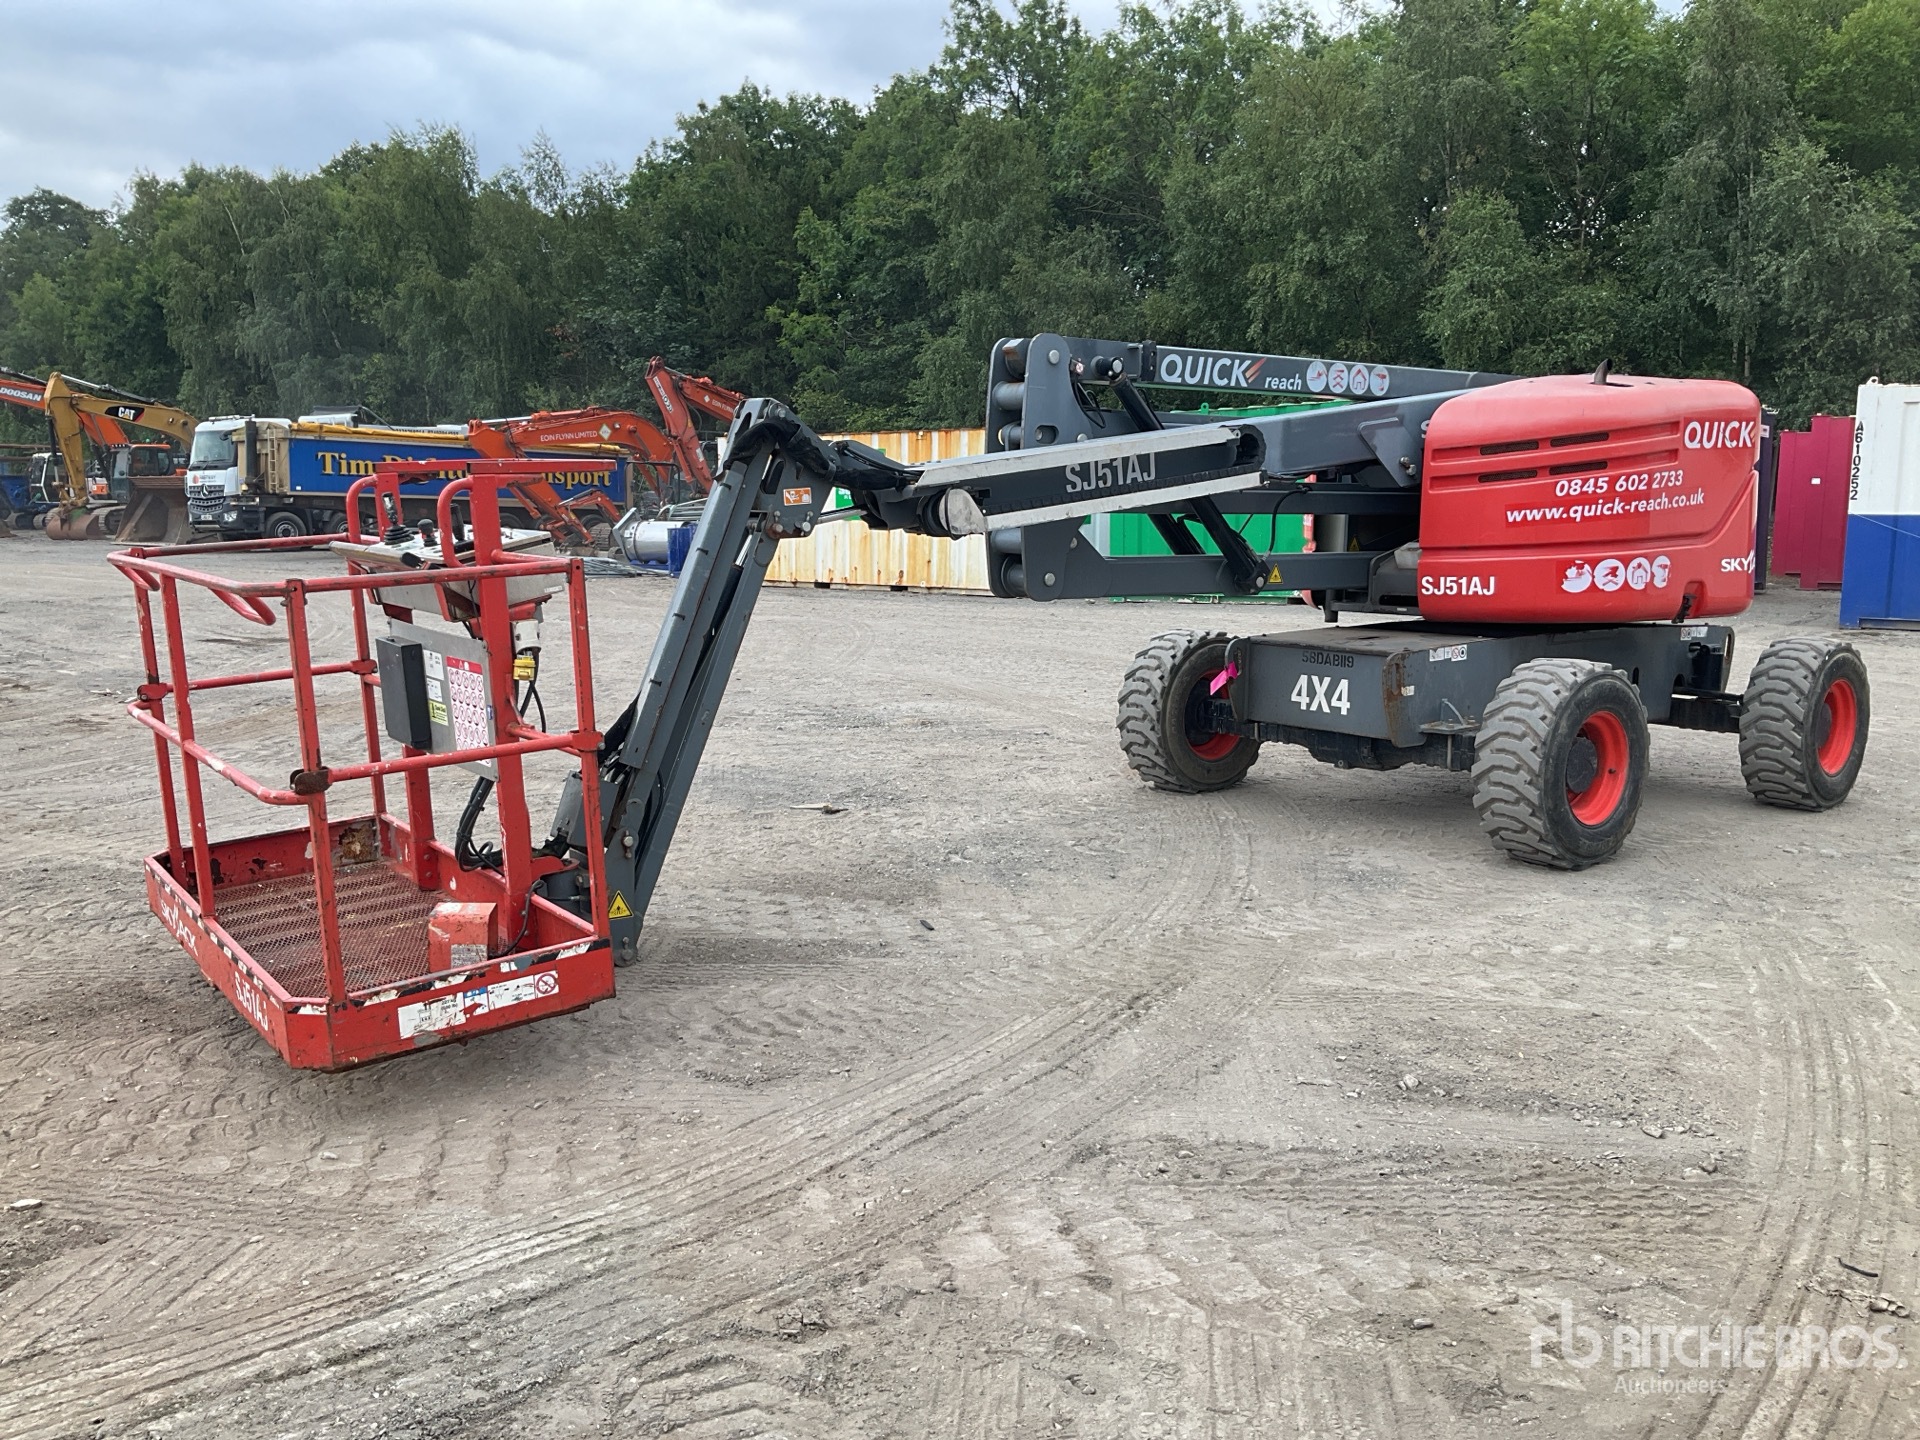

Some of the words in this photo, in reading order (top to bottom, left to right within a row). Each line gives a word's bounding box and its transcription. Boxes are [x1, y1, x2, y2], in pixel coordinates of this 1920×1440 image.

[1160, 353, 1252, 388] QUICK
[1265, 373, 1302, 391] reach
[0, 387, 42, 401] DOOSAN
[118, 406, 136, 421] CAT
[555, 432, 574, 440] FLYNN
[574, 430, 598, 439] LIMITED
[1684, 421, 1755, 450] QUICK
[318, 452, 374, 475] Tim
[1065, 451, 1156, 493] SJ51AJ
[1850, 420, 1864, 500] A610252
[1555, 477, 1609, 497] 0845
[1615, 474, 1649, 492] 602
[1652, 469, 1684, 489] 2733
[1506, 488, 1705, 522] www.quick-reach.co.uk
[1421, 575, 1495, 595] SJ51AJ
[1290, 674, 1351, 716] 4X4
[234, 970, 269, 1031] SJ51AJ
